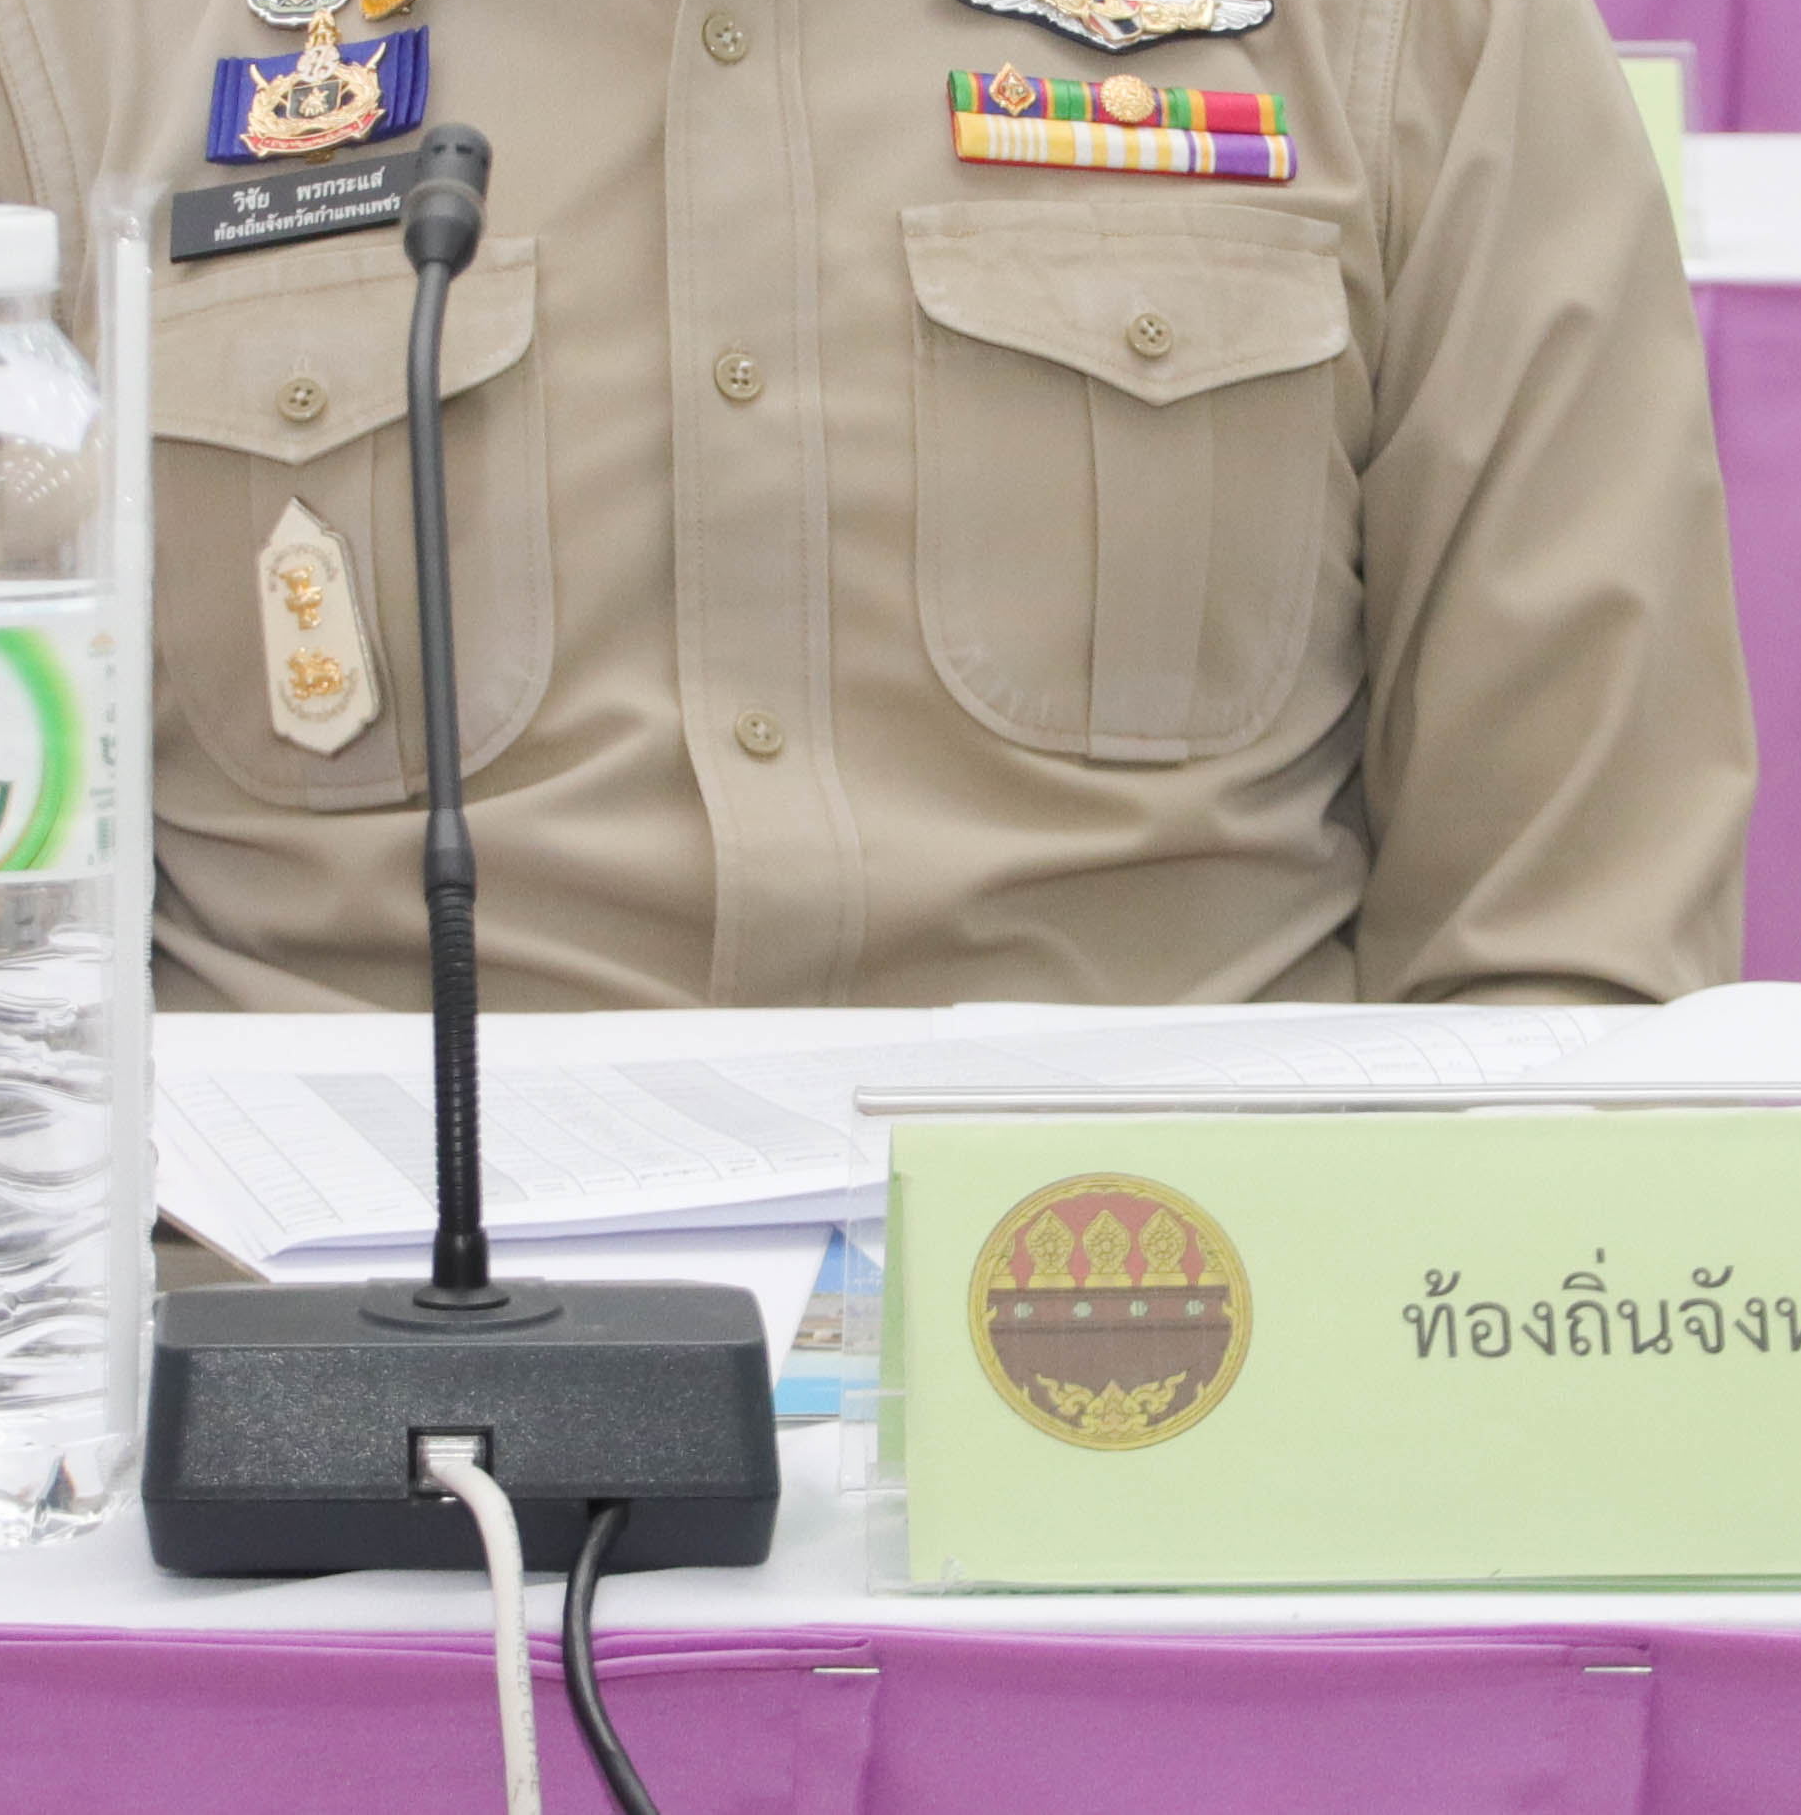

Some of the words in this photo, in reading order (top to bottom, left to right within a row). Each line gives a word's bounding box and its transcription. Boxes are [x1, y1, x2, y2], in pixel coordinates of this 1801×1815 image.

[213, 193, 401, 242] ท้องถิ่นจังหวัดกำแพงเพชร
[233, 188, 271, 213] วิชัย
